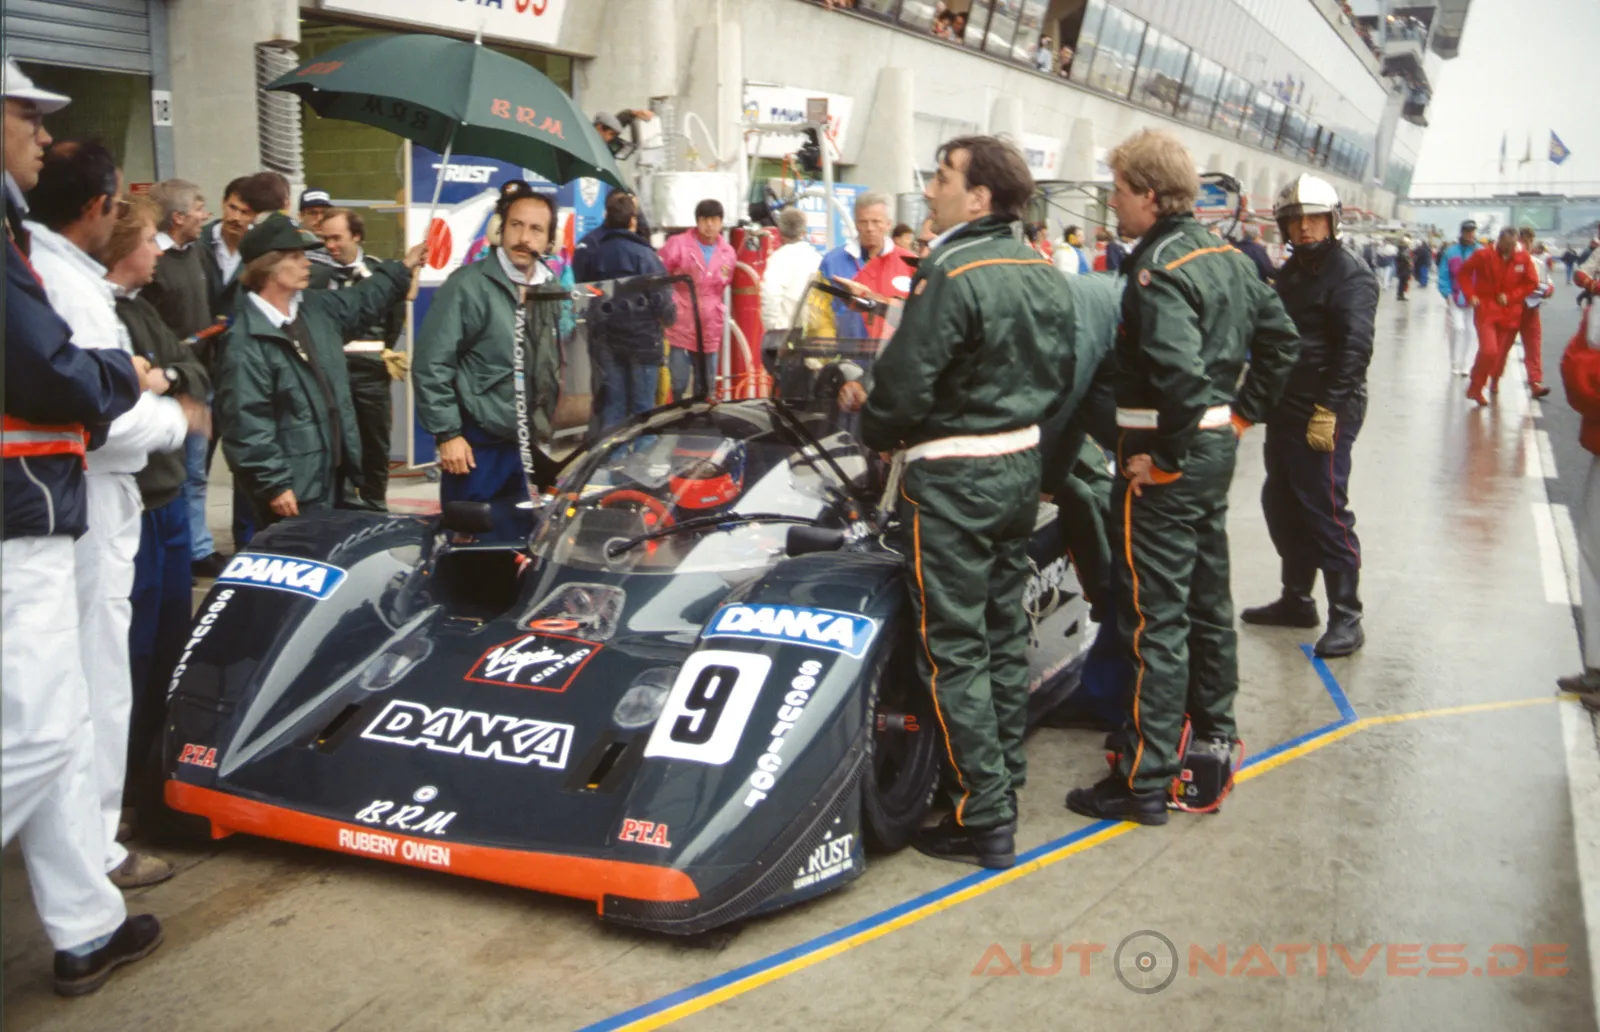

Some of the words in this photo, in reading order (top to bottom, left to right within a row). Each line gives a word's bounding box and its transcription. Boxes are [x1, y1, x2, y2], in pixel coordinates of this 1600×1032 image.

[515, 391, 535, 474] TOIVONEN
[219, 556, 328, 593] DANKA
[715, 606, 854, 649] DANKA
[484, 635, 564, 682] Virgin
[530, 648, 591, 683] cargo
[669, 663, 741, 745] 9
[360, 699, 575, 769] DANKA
[743, 660, 823, 808] Securicor
[338, 828, 399, 857] RUBERY
[401, 840, 451, 867] OWEN
[797, 833, 853, 876] RUST
